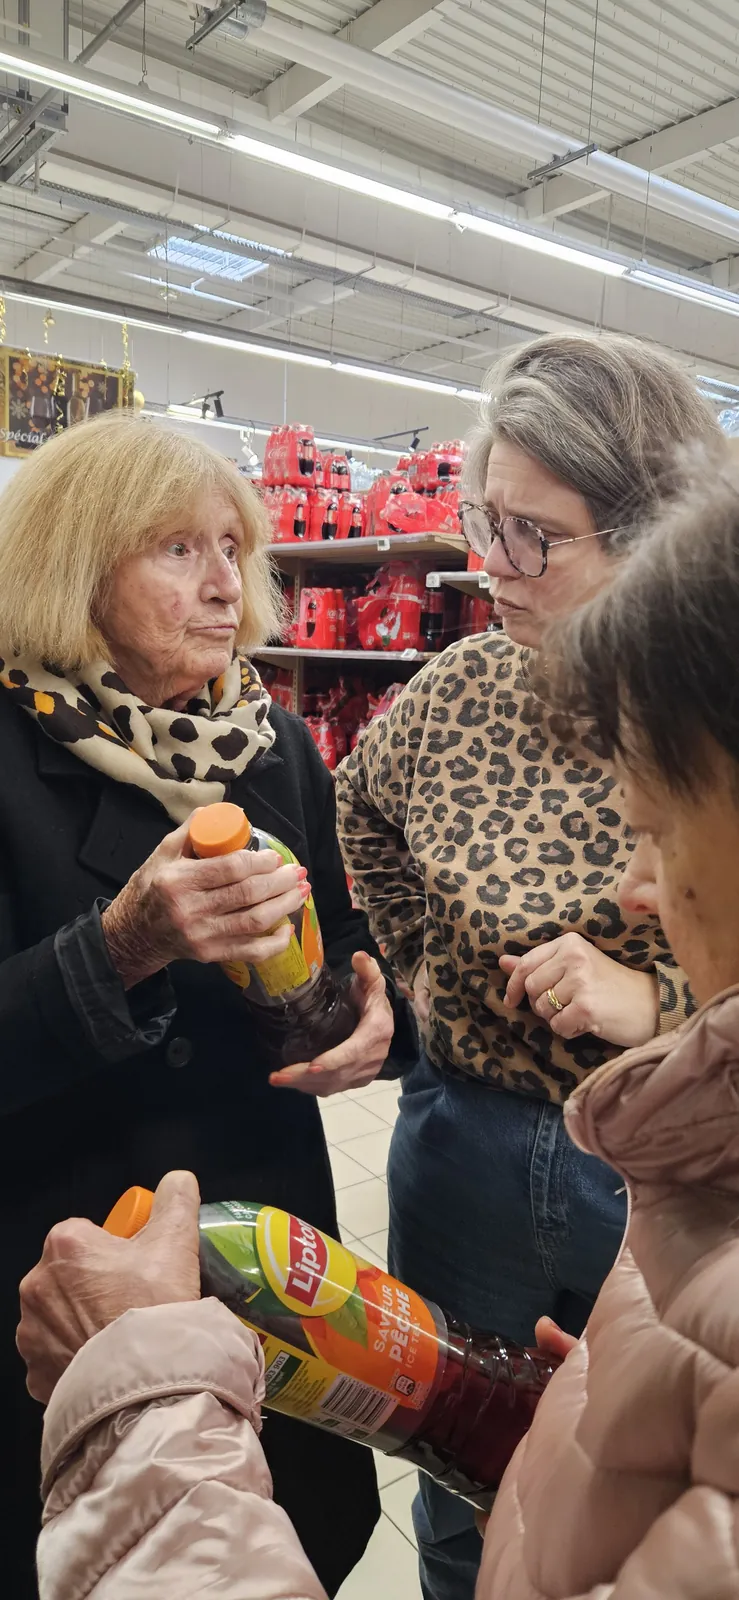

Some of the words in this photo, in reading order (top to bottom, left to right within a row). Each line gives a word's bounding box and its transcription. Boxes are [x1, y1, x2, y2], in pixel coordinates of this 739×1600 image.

[0, 428, 46, 444] Spécial
[373, 1284, 393, 1353] SAVEUR
[389, 1287, 411, 1363] PÊCHE
[273, 1356, 286, 1370] 903
[405, 1346, 417, 1368] ICE
